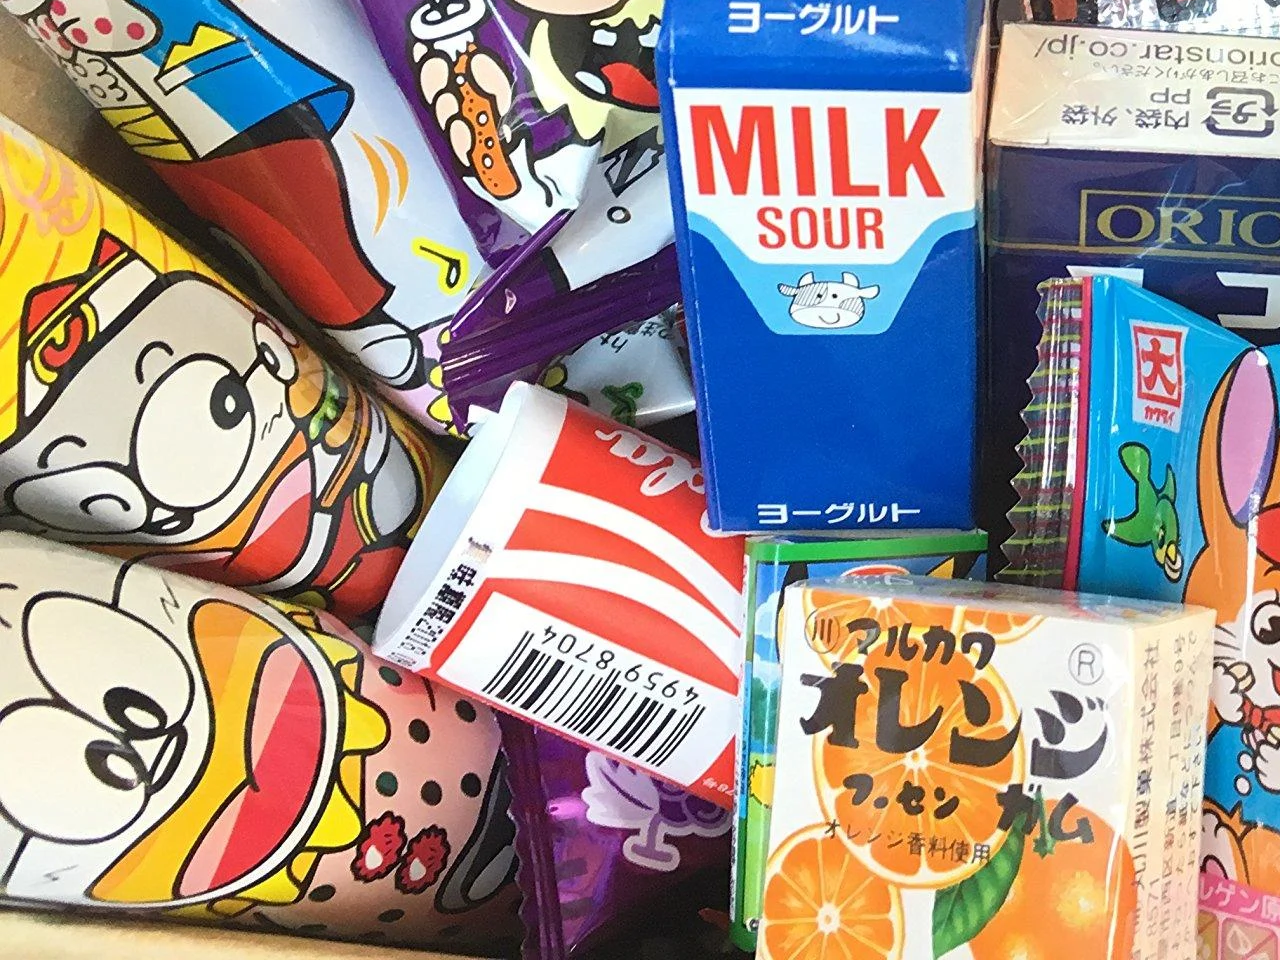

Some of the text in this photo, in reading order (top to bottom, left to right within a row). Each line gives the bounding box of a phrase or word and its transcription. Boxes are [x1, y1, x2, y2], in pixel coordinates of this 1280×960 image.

[728, 1, 900, 36] ヨーグルト
[1150, 86, 1191, 106] PP
[690, 105, 945, 198] MILK
[757, 207, 885, 250] SOUR
[757, 503, 921, 525] ヨーグルト
[541, 624, 699, 707] 4959 8704
[846, 617, 997, 670] マルカワ
[800, 663, 1109, 781] オレンジ
[843, 774, 961, 821] フーセン
[824, 819, 992, 867] オレンジ香料使用
